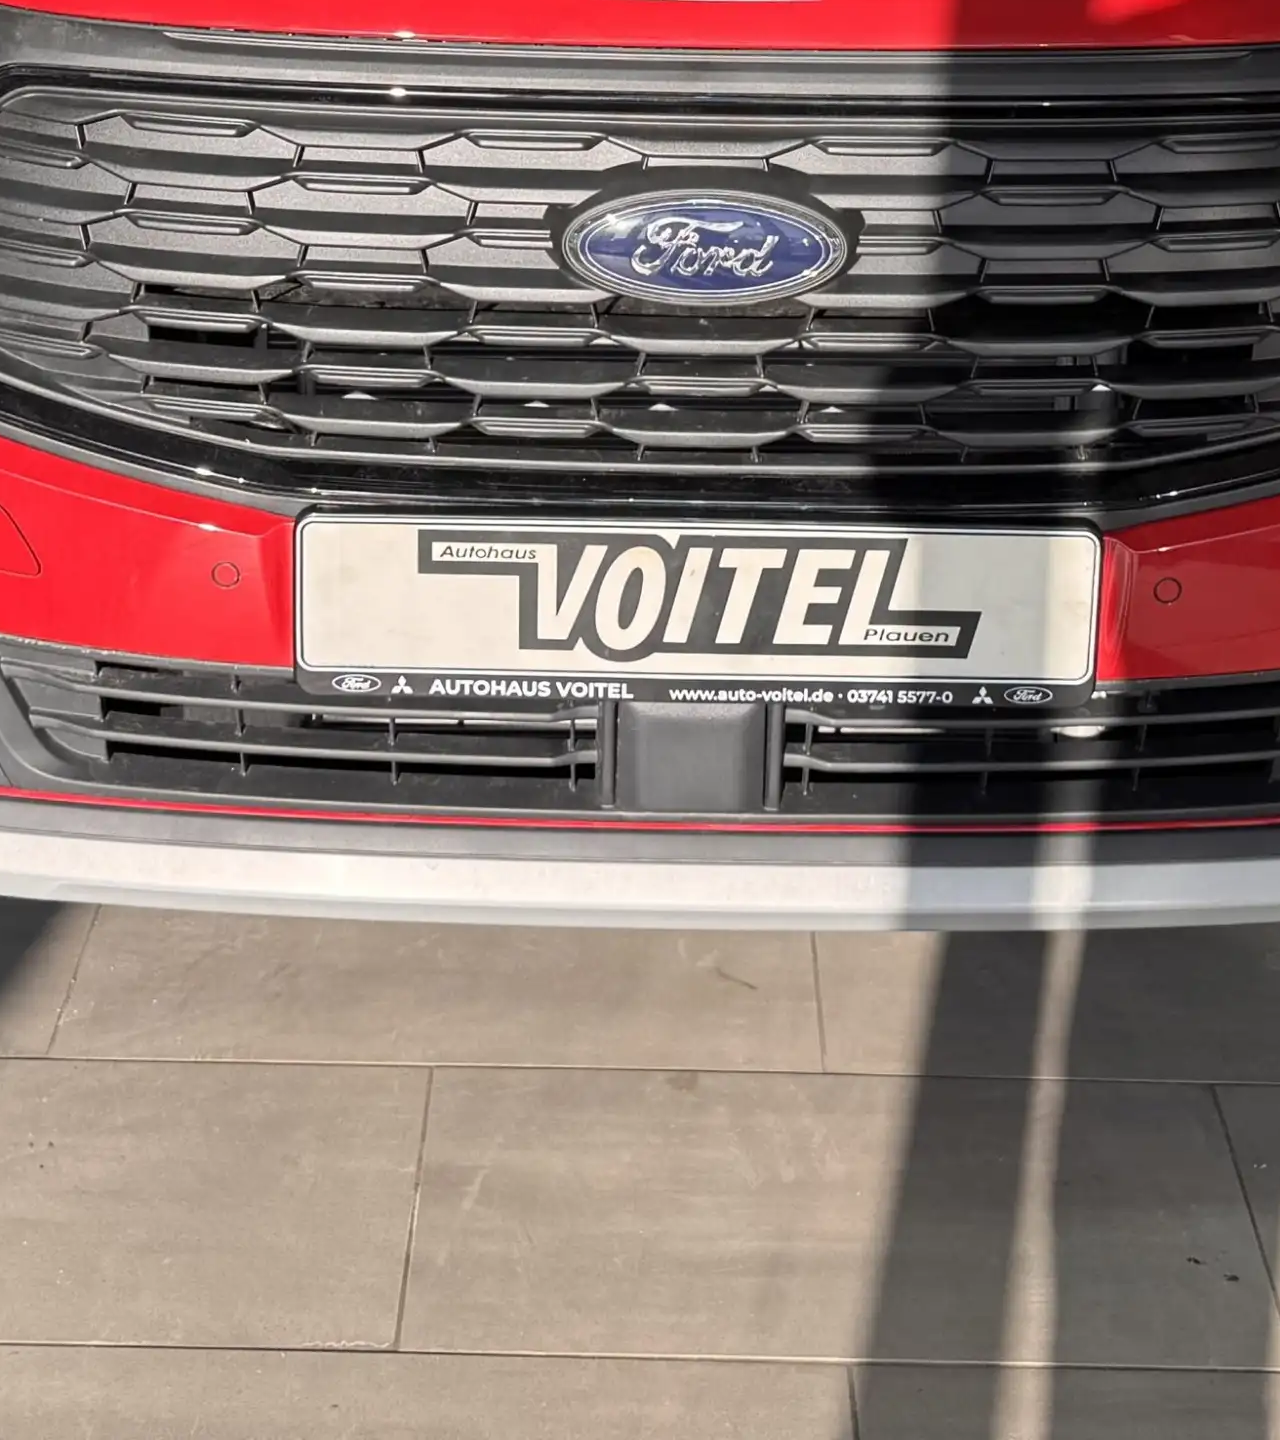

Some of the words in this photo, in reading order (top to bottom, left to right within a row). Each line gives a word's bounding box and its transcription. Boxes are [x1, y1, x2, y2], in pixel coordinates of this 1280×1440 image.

[631, 216, 780, 277] Ford
[439, 543, 537, 560] Autohaus
[537, 543, 892, 651] VOITEL
[862, 626, 950, 645] Plauen
[428, 678, 552, 697] AUTOHAUS
[555, 681, 634, 700] VOITEL
[668, 687, 835, 703] www.auto-voitel.de
[846, 689, 893, 704] 03741
[896, 690, 954, 705] 5577-0
